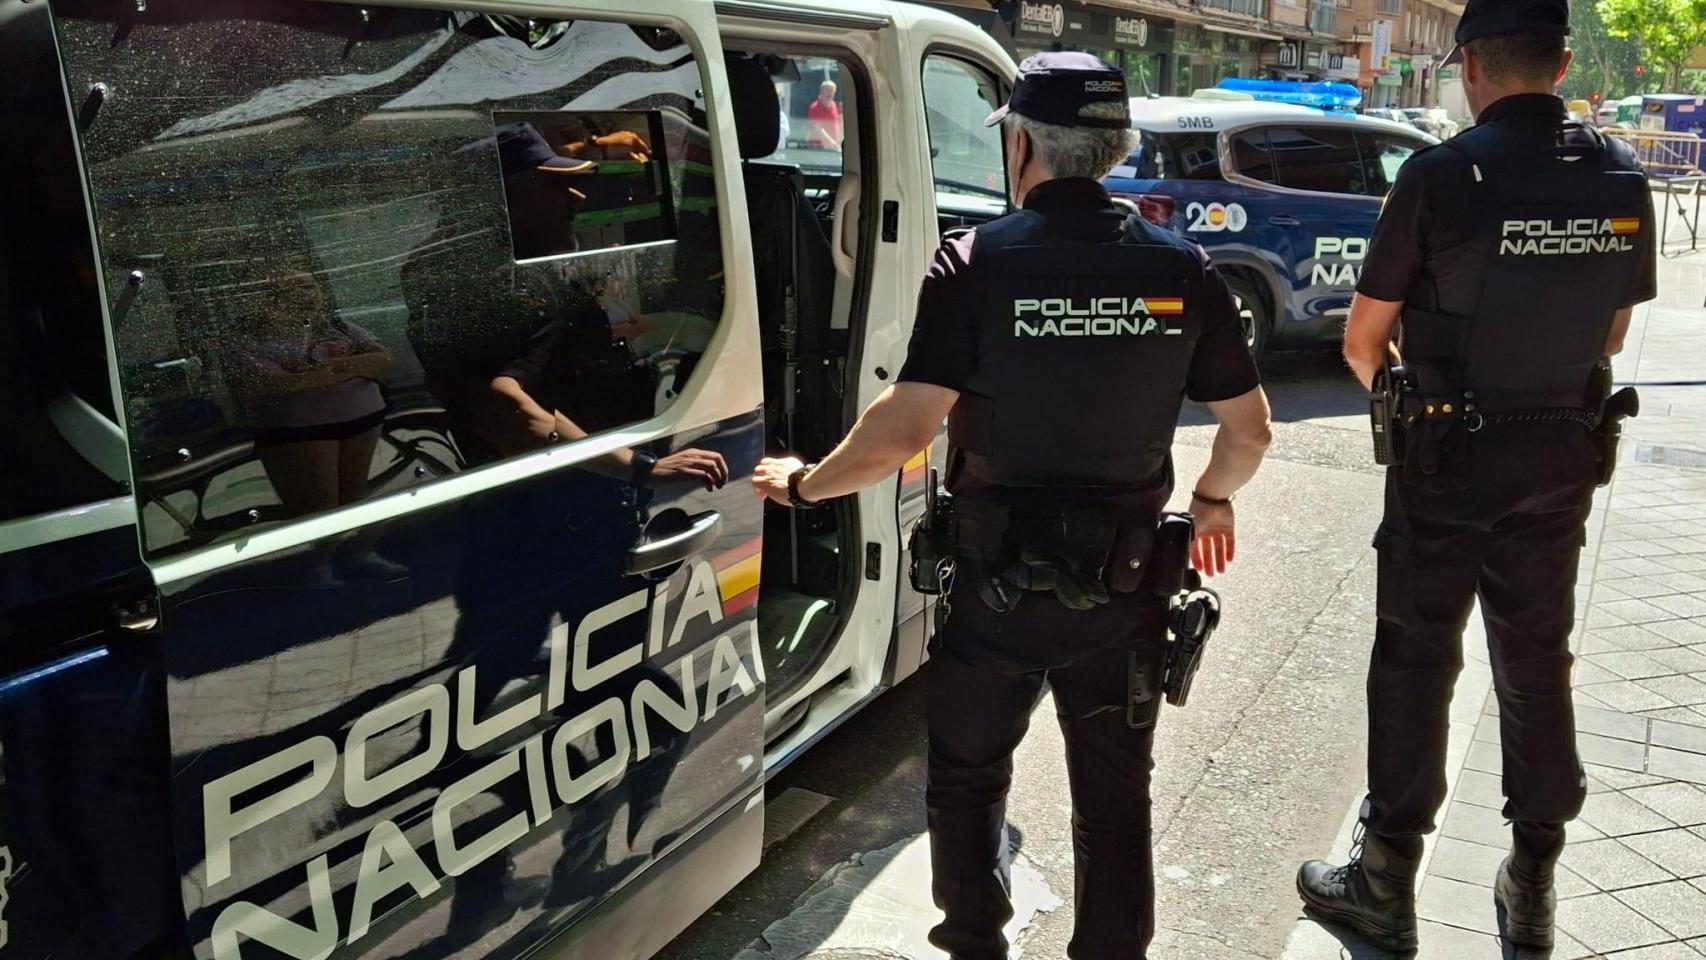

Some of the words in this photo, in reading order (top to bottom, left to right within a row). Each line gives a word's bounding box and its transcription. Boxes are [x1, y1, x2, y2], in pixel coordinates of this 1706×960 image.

[1177, 116, 1214, 129] 5MB
[1186, 202, 1247, 232] 200
[1502, 219, 1614, 237] POLICIA
[1314, 237, 1371, 260] PO
[1500, 236, 1633, 255] NACIONAL
[1311, 263, 1362, 286] NA
[1015, 298, 1149, 316] POLICIA
[203, 560, 723, 887] POLICIA
